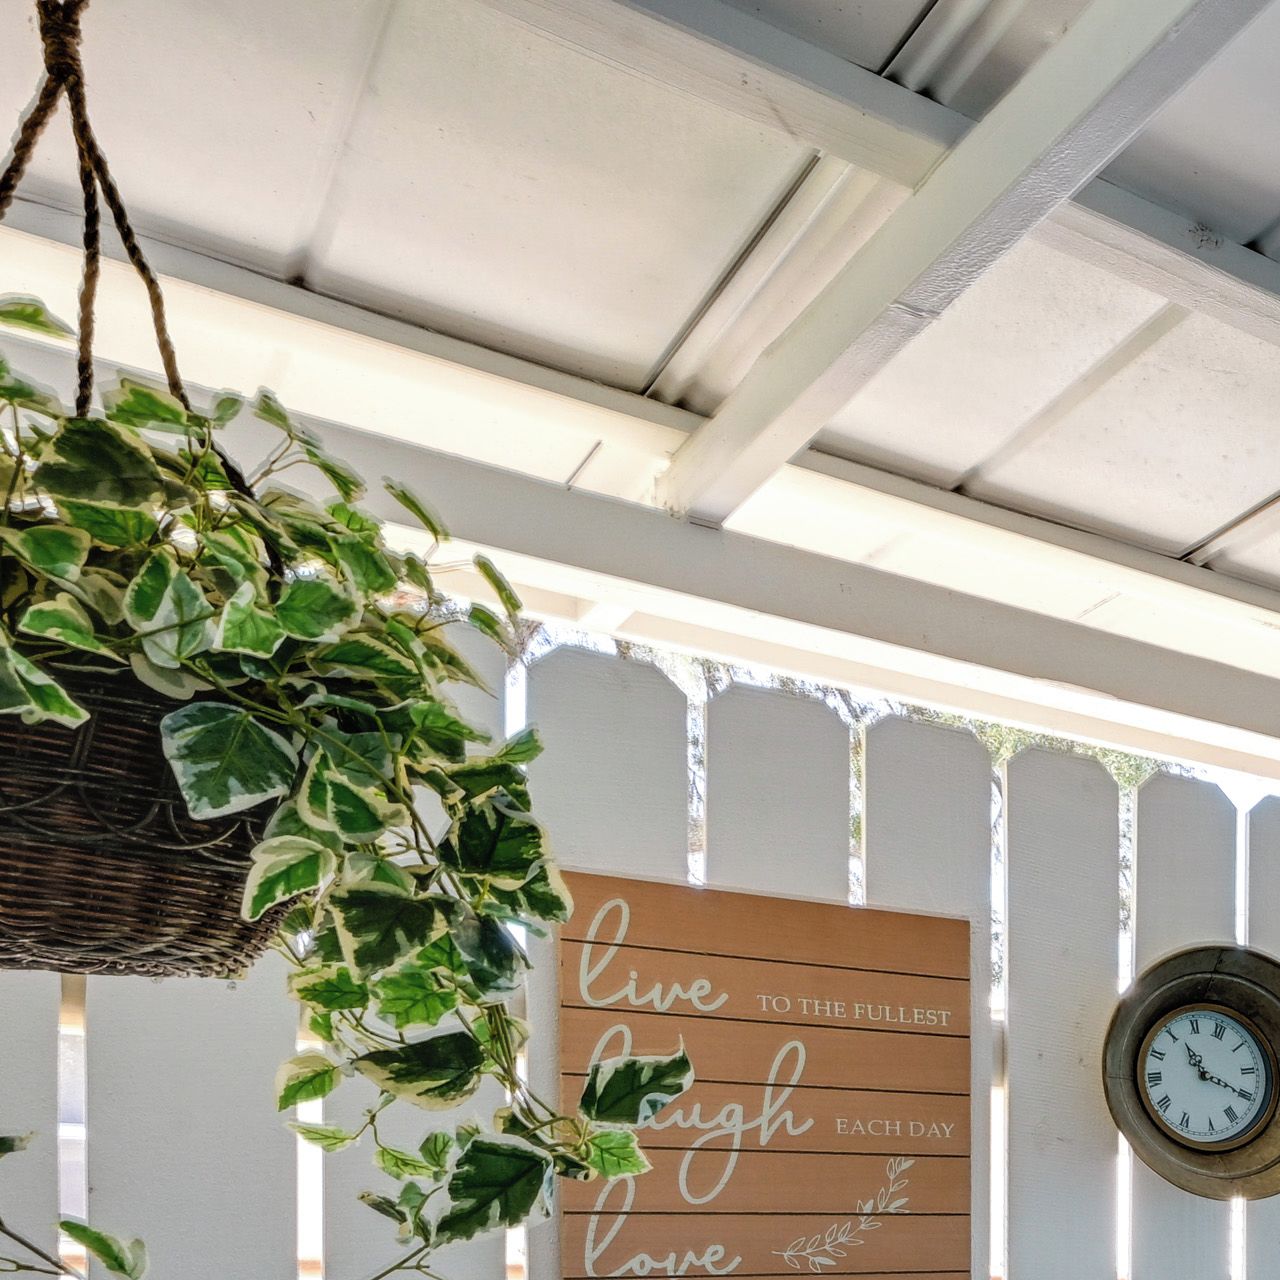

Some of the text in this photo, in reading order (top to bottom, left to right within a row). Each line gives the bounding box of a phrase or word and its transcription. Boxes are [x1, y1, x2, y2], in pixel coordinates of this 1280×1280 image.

[579, 897, 952, 1027] live TO THE FULLEST
[588, 1024, 954, 1205] ugh EACH DAY
